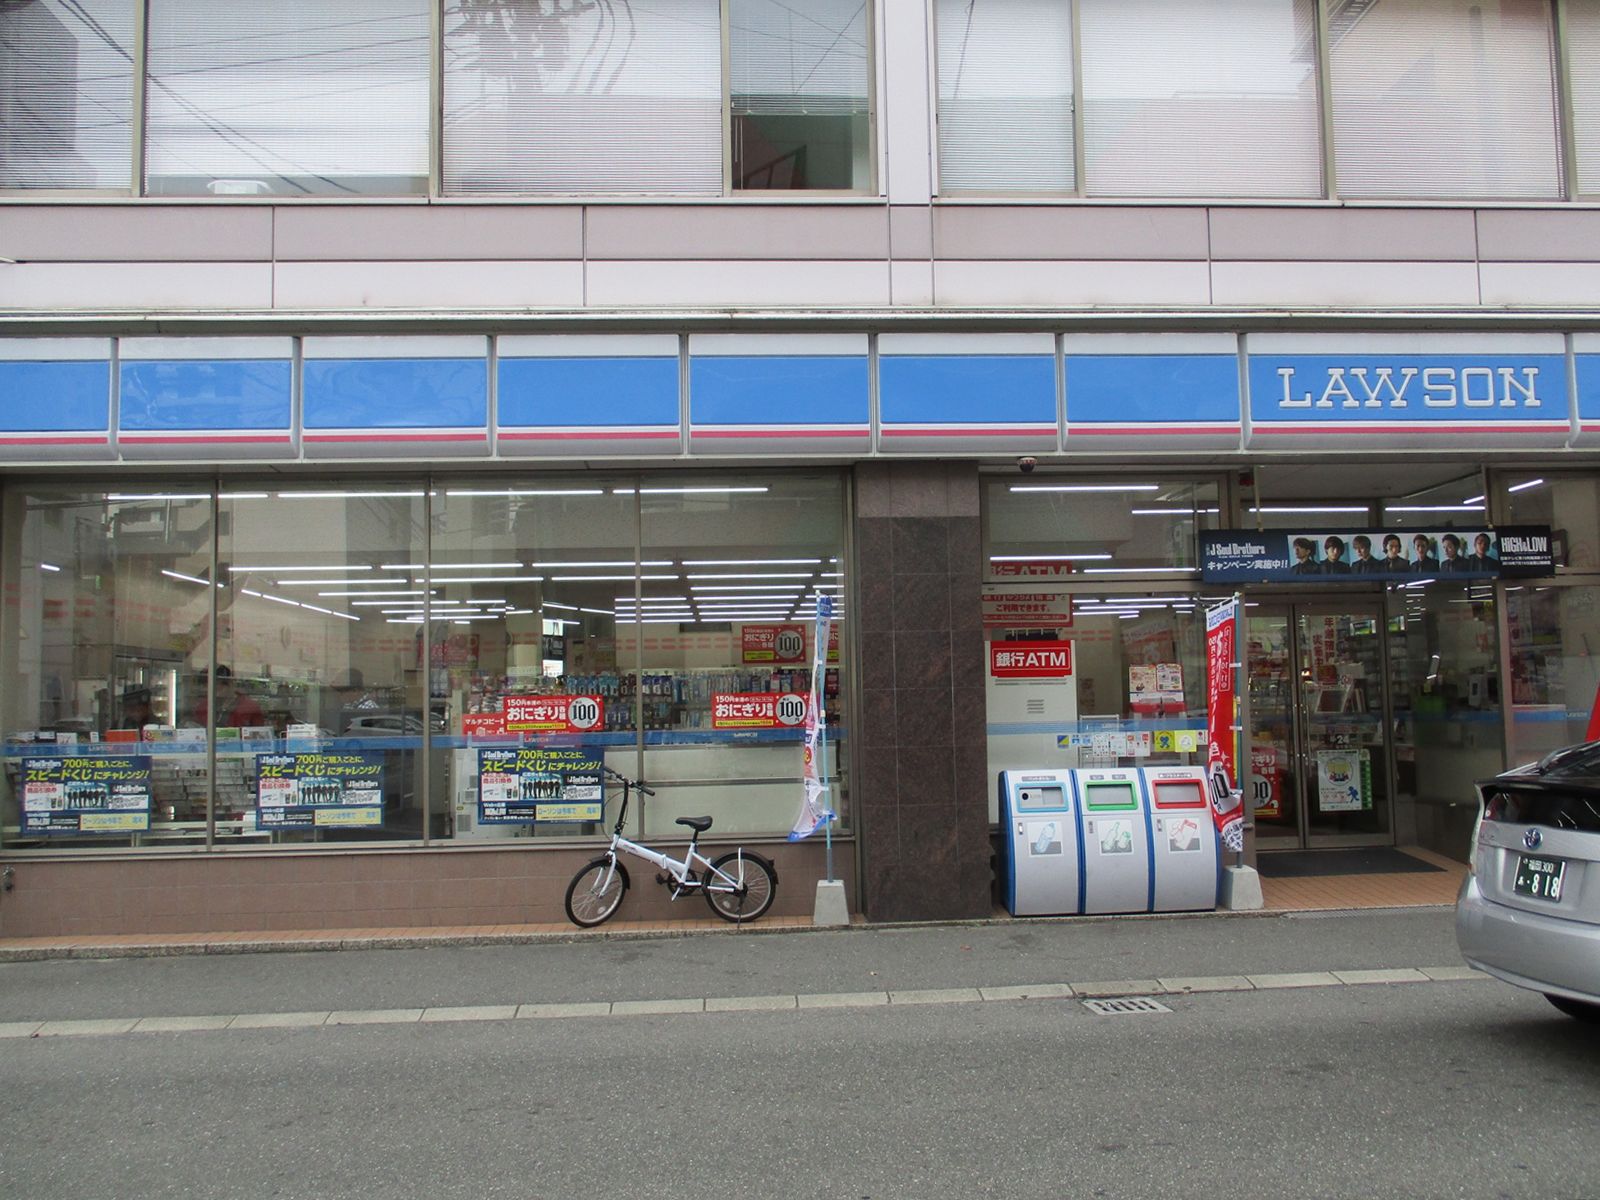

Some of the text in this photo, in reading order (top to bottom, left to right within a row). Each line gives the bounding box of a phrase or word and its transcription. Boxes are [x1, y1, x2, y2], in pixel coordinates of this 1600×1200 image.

[1277, 367, 1541, 408] LAWSON
[1210, 544, 1215, 556] J
[1216, 543, 1232, 555] Soul
[1232, 542, 1265, 555] Brothers
[779, 636, 800, 652] 100
[996, 652, 1066, 667] 銀行ATM
[507, 706, 559, 720] おにぎり
[571, 703, 596, 720] 100
[716, 703, 766, 717] おにぎり
[780, 701, 804, 717] 100
